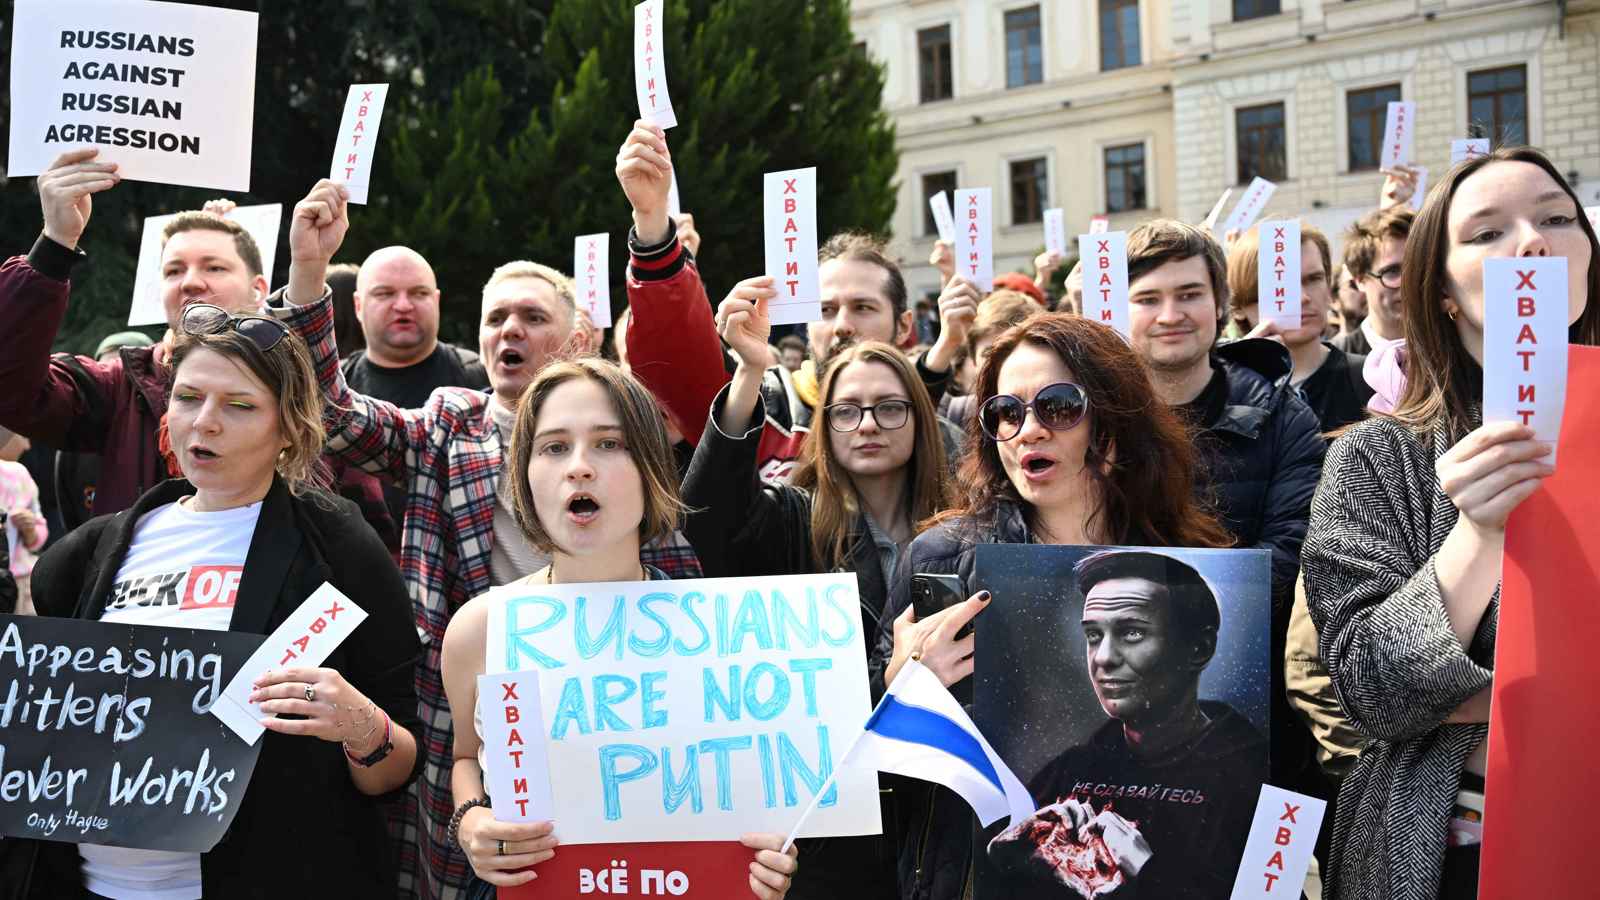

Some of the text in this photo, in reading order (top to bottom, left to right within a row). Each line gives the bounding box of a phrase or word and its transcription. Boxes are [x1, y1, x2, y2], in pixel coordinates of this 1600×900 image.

[60, 30, 195, 57] RUSSIANS
[63, 61, 185, 87] AGAINST
[44, 124, 200, 155] AGRESSION
[61, 92, 182, 120] RUSSIAN
[345, 90, 373, 180] ХВАТИТ
[587, 241, 597, 312] ХВАТИТ
[783, 178, 799, 297] ХВАТИТ
[968, 195, 978, 275] ХВАТИТ
[1274, 227, 1285, 312] ХВАТИТ
[1097, 240, 1112, 327] ХВАТИ
[1515, 270, 1537, 426] ХВАТИТ
[0, 622, 222, 715] Appeasing
[505, 583, 856, 671] RUSSIANS
[550, 657, 833, 741] ARE NOT
[0, 744, 236, 816] ever Works
[501, 682, 529, 817] ХВАТИТ
[599, 721, 838, 822] PUTIN
[26, 808, 109, 836] Only Hague
[579, 859, 689, 896] ВСЁ ПО
